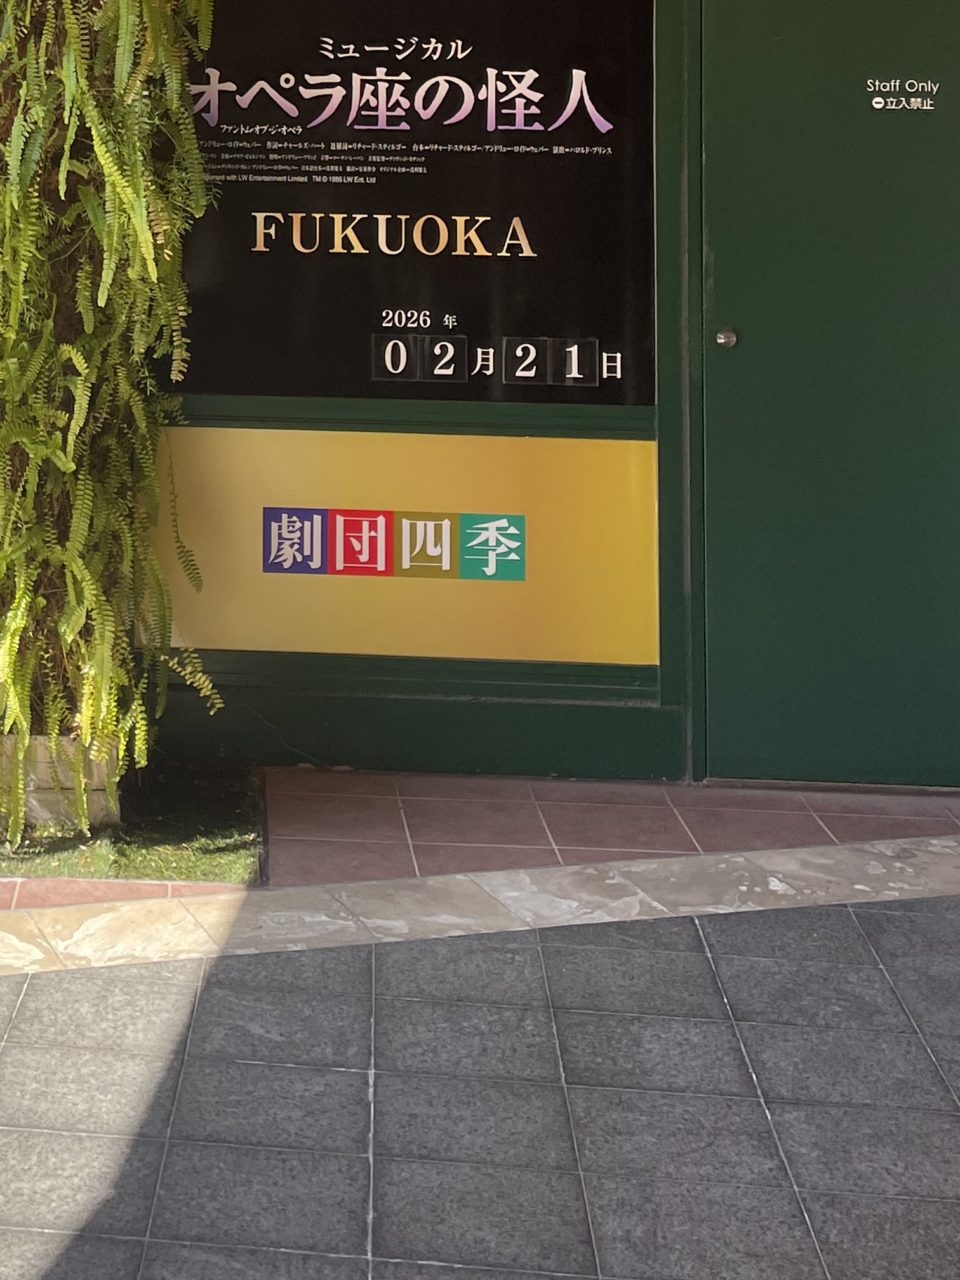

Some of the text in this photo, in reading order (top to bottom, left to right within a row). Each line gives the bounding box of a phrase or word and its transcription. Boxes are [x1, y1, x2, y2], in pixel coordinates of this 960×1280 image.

[318, 36, 473, 61] ミュージカル
[189, 66, 614, 135] オペラ座の怪人
[866, 79, 940, 95] Staff Only
[885, 97, 935, 110] 立入禁止
[250, 211, 538, 257] FUKUOKA
[268, 513, 522, 576] 劇団四季
